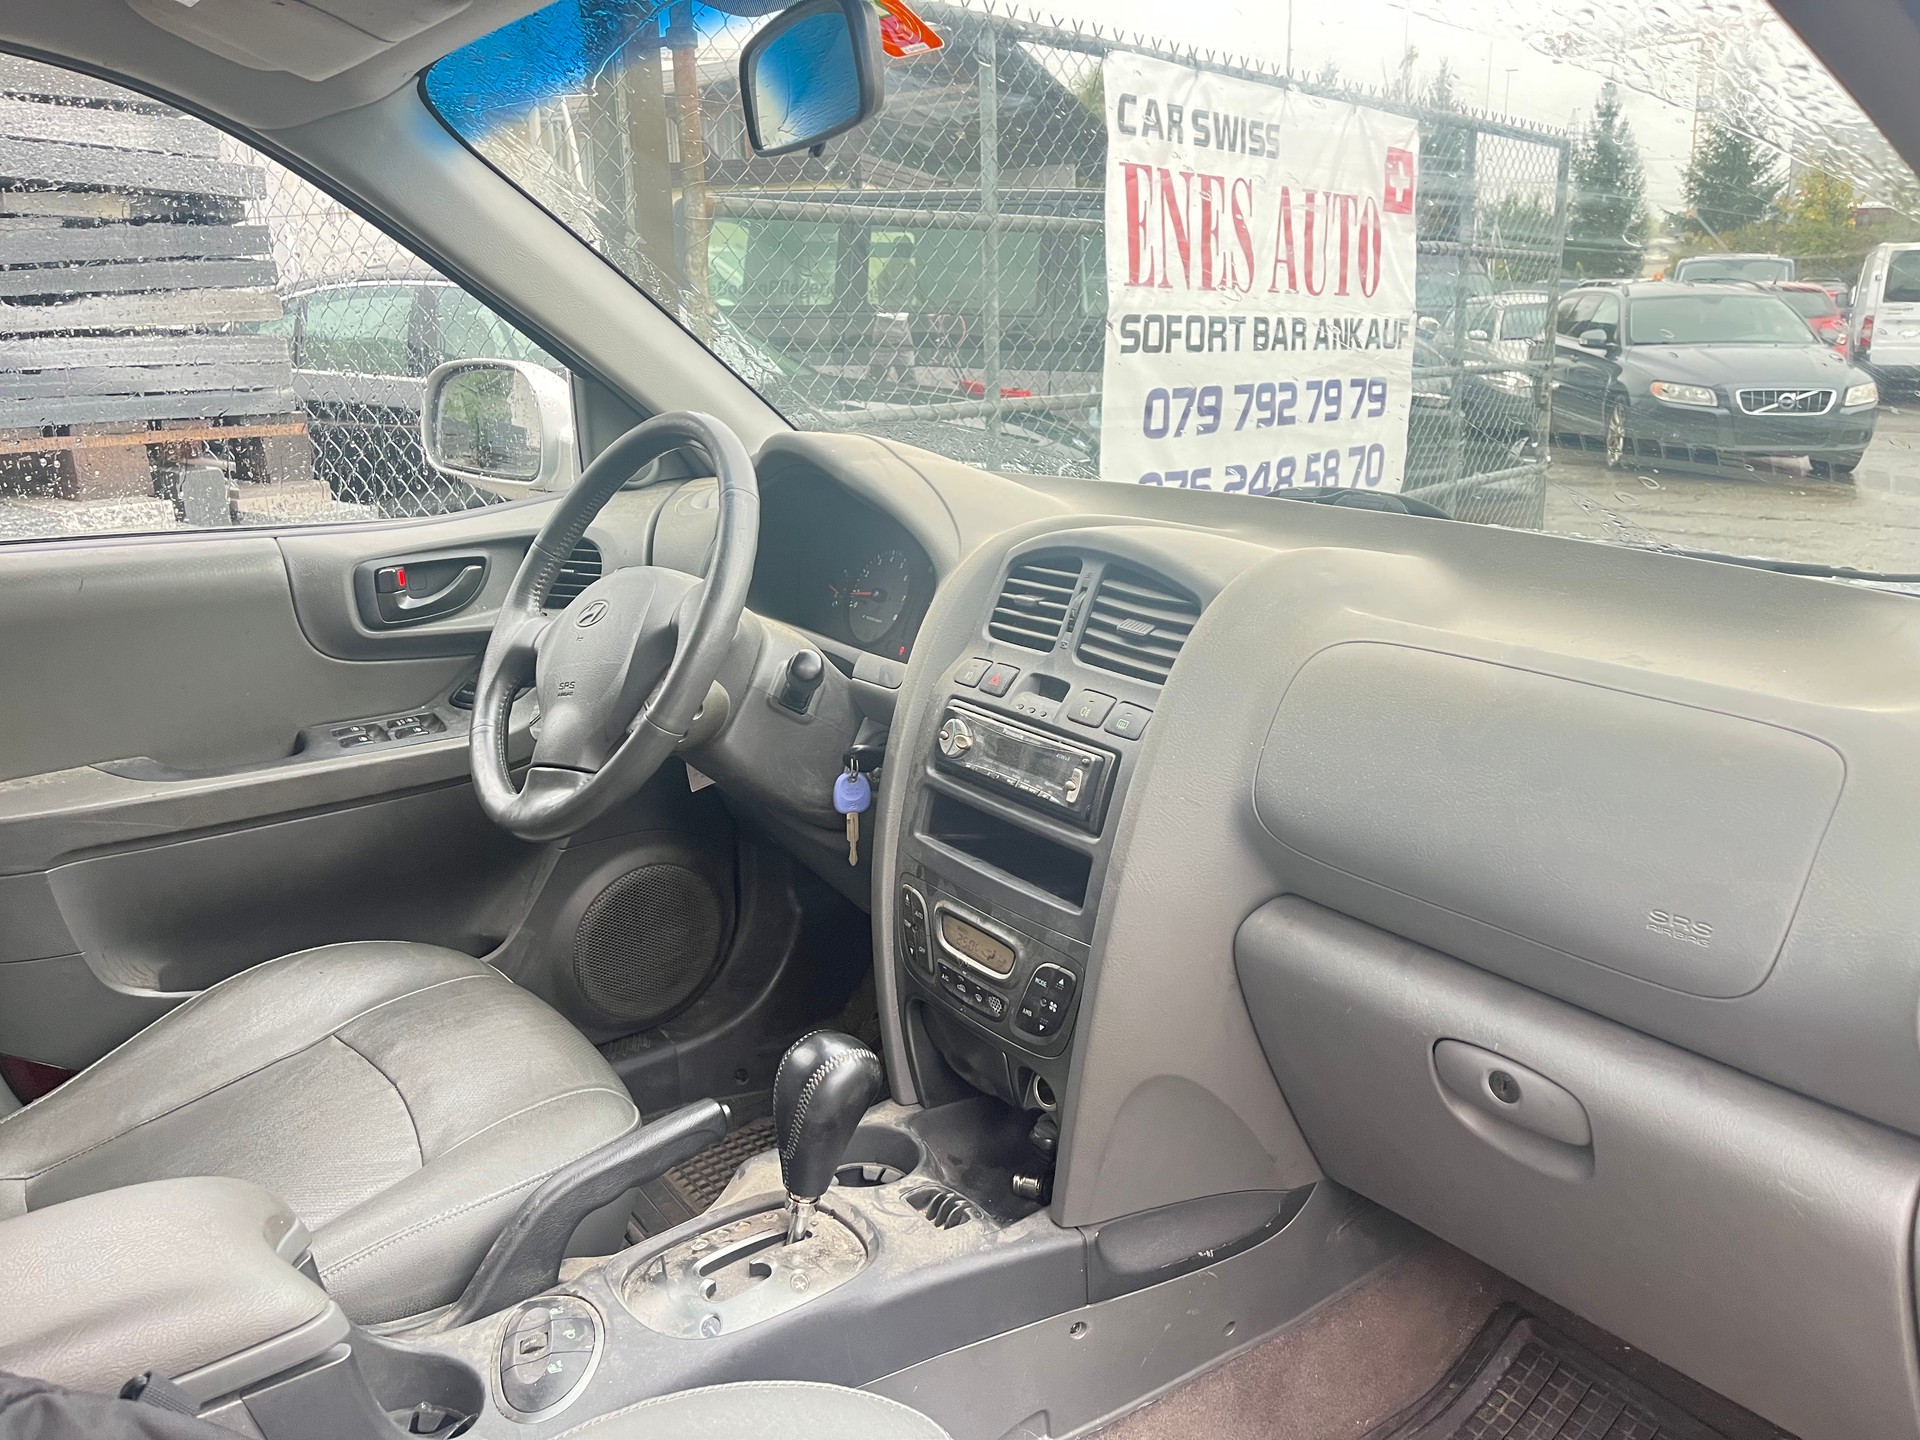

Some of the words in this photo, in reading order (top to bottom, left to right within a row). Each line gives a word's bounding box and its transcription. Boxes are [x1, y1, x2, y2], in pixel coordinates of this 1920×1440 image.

[1117, 93, 1184, 145] CAR
[1191, 109, 1281, 160] SWISS
[1119, 161, 1255, 293] ENES
[1268, 185, 1382, 298] AUTO
[1120, 313, 1246, 354] SOFORT
[1253, 315, 1307, 352] BAR
[1313, 318, 1409, 351] ANKAUF
[1142, 384, 1223, 439] 079
[1234, 381, 1298, 431] 792
[1306, 378, 1342, 424] 79
[1350, 376, 1388, 420] 79
[1223, 456, 1297, 495] 248
[1304, 448, 1340, 487] 58
[1348, 443, 1385, 488] 70
[558, 681, 576, 690] SRS
[1648, 909, 1714, 938] SRS
